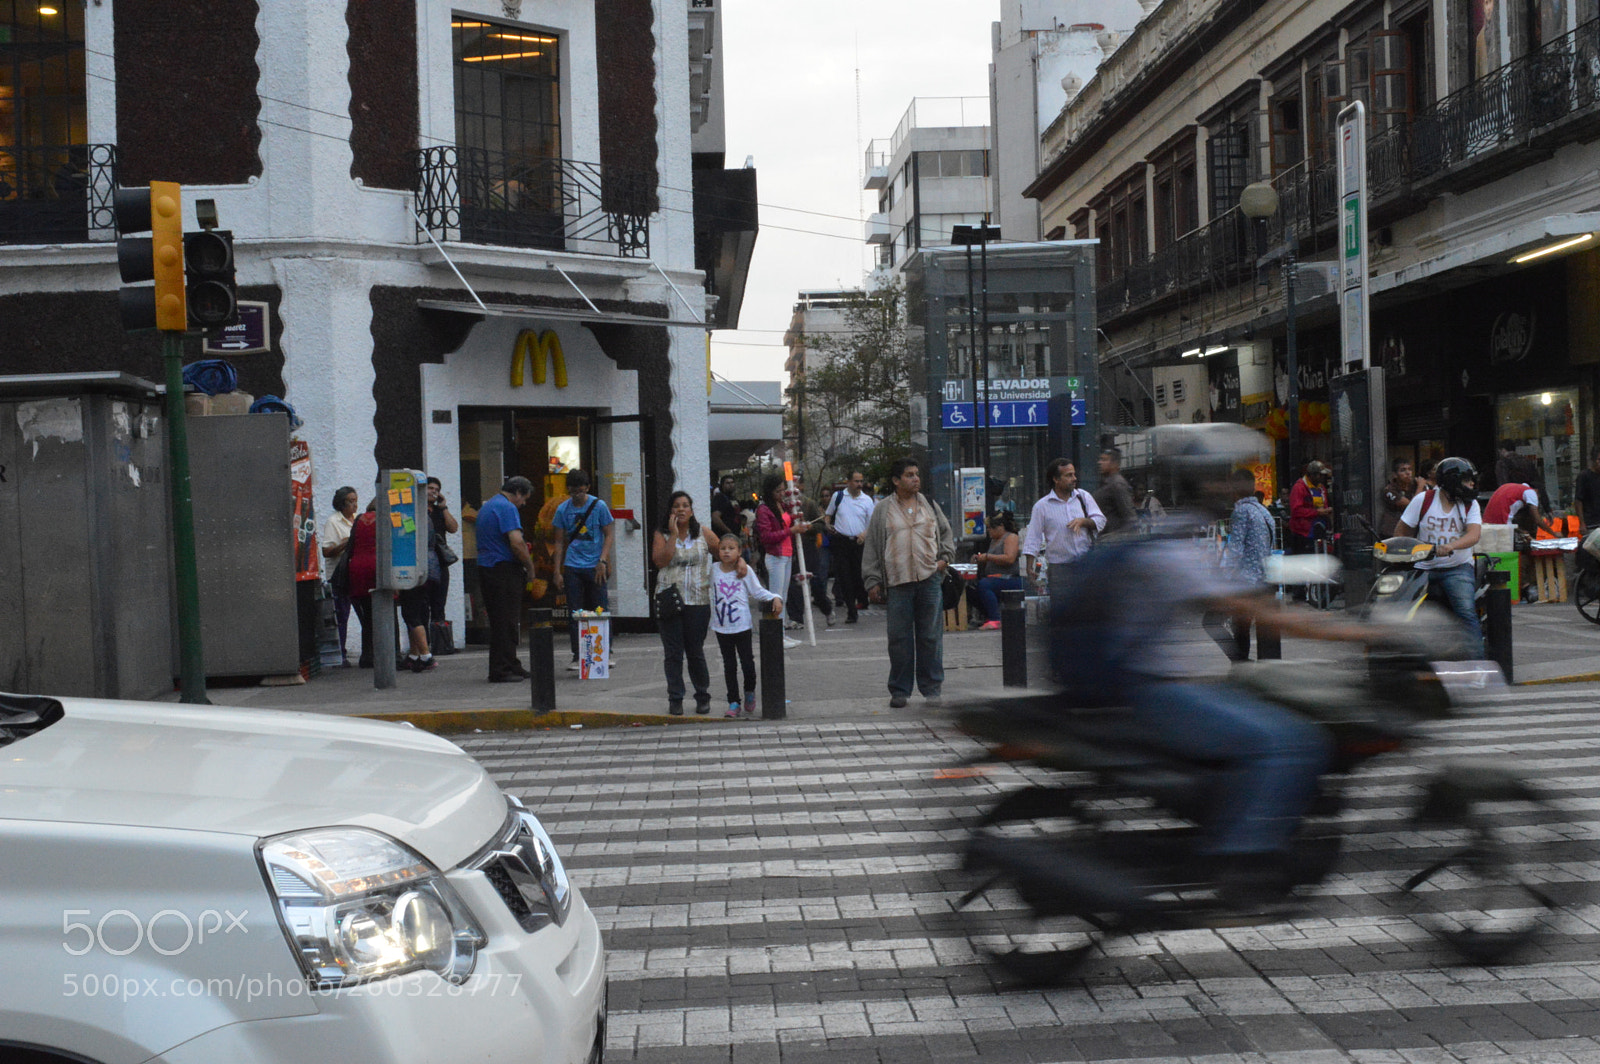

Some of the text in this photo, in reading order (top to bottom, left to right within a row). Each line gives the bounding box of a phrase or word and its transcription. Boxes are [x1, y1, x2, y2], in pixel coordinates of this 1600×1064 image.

[1067, 379, 1079, 387] L2
[976, 390, 1051, 400] Plza Universidad
